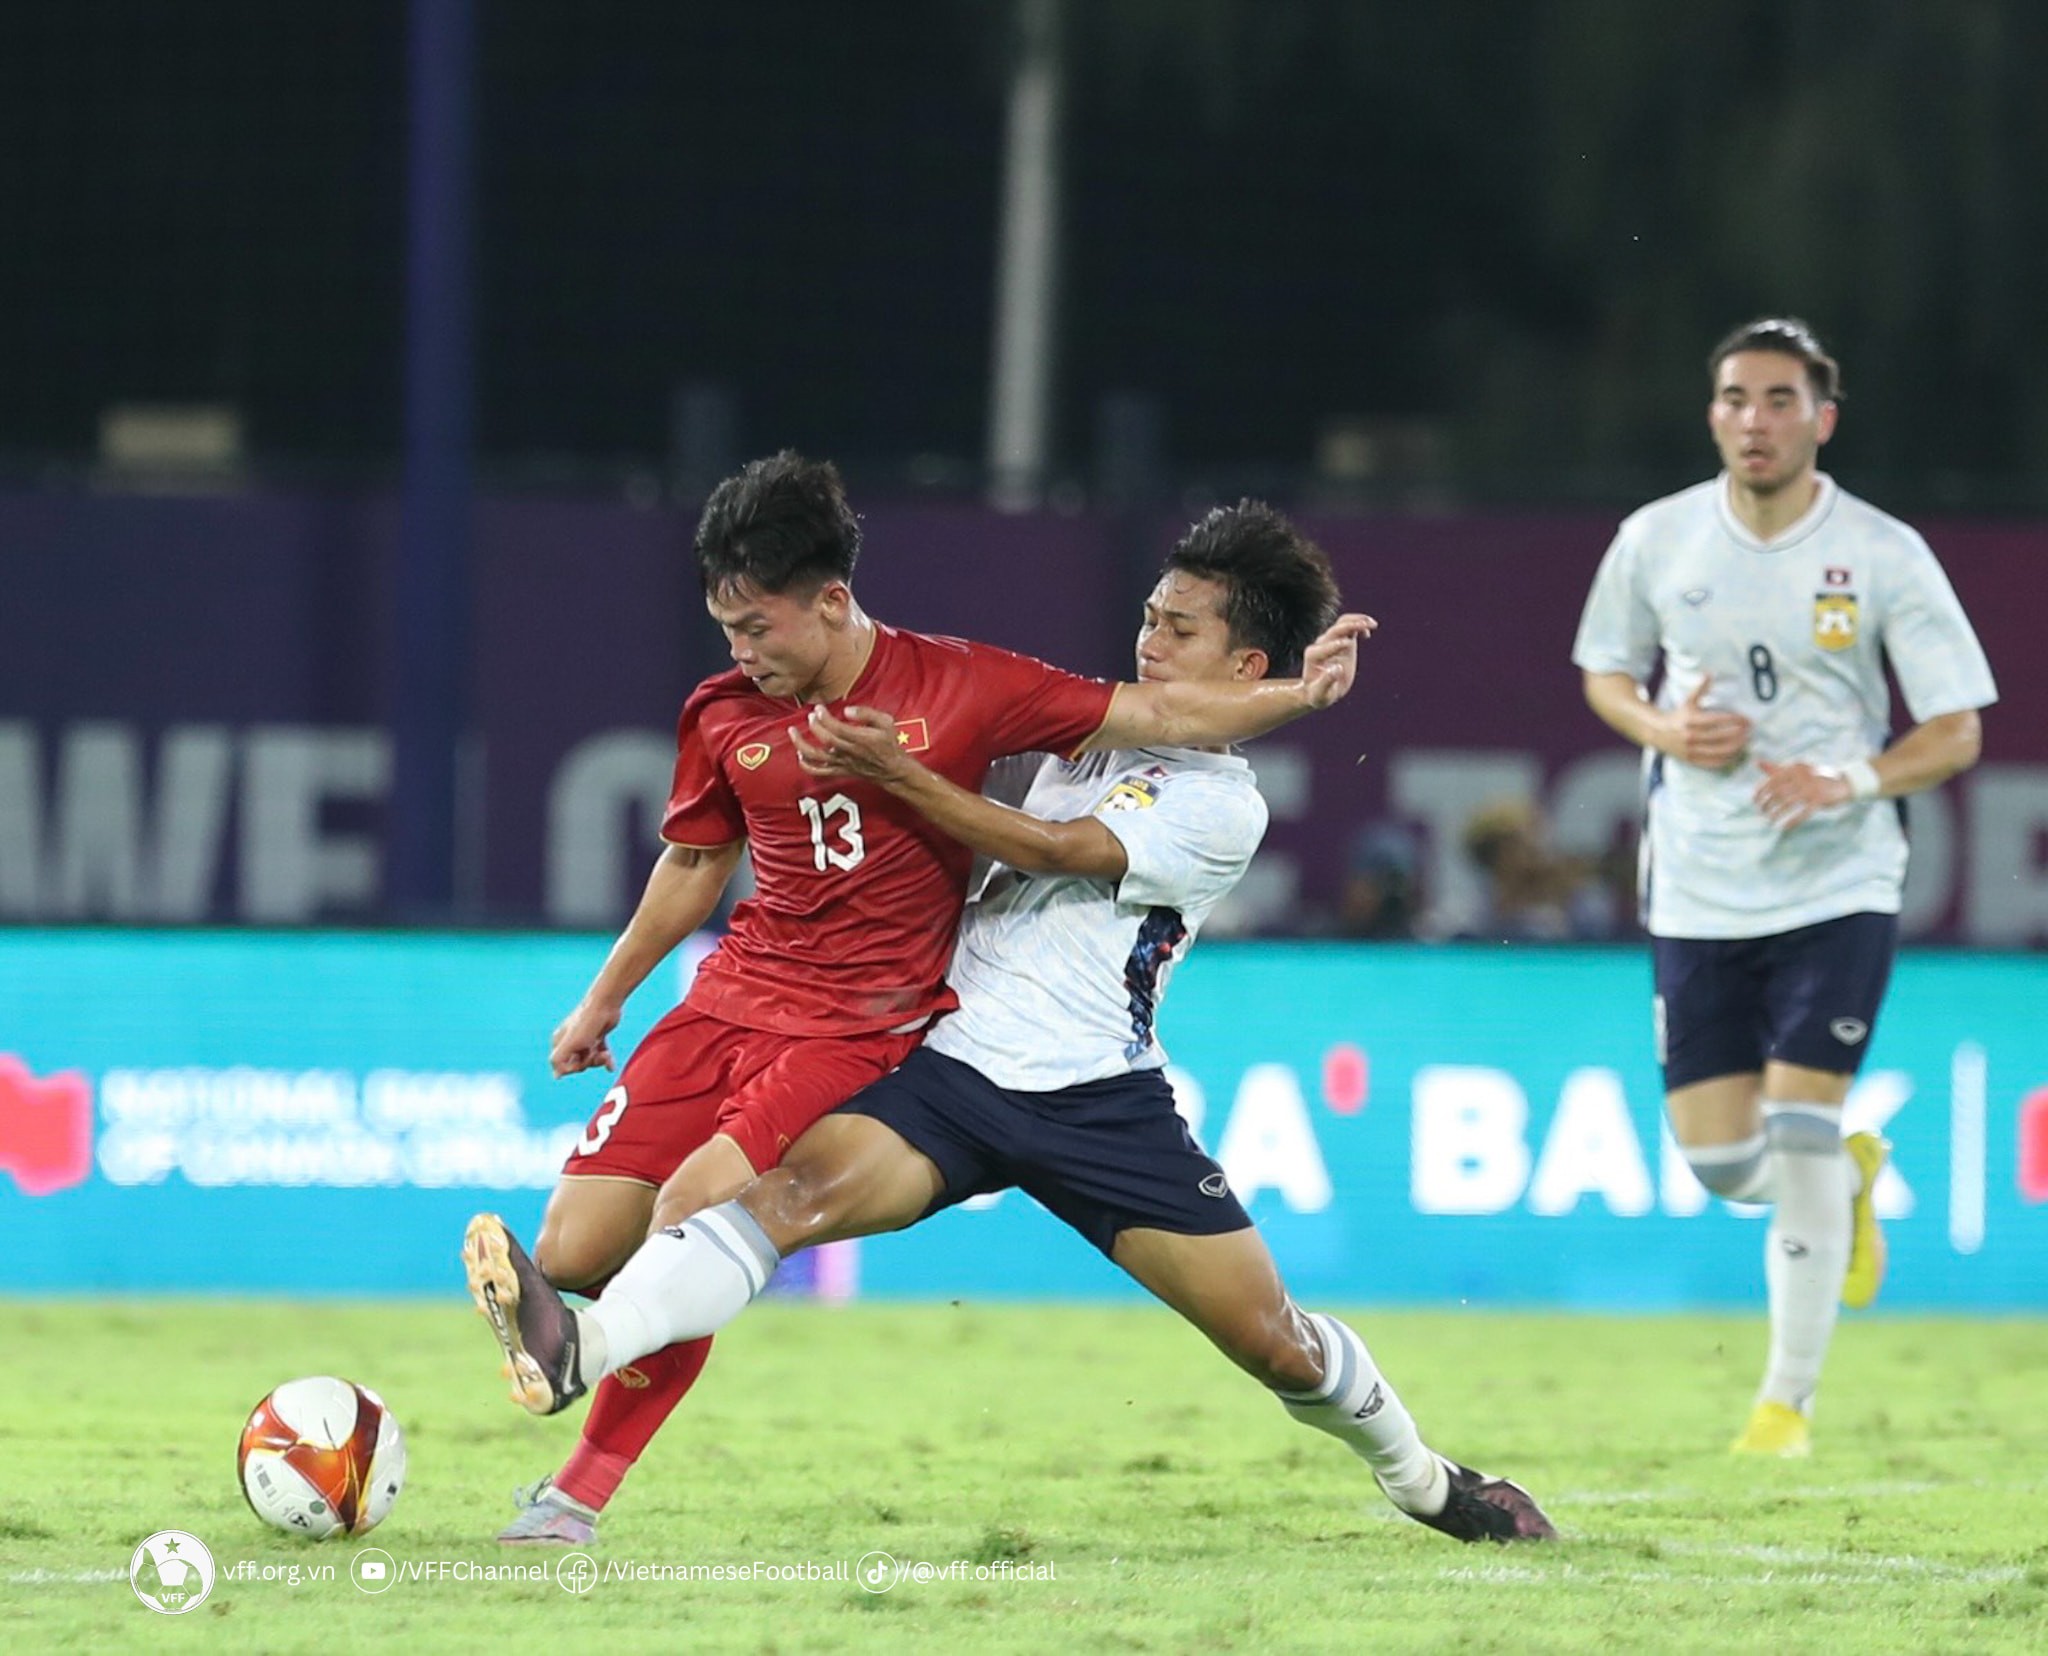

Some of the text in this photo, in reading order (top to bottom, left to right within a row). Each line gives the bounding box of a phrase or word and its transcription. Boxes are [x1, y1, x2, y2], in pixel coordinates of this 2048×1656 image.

[1749, 644, 1777, 702] 8
[798, 793, 865, 872] 13
[1410, 1063, 1915, 1219] BAK
